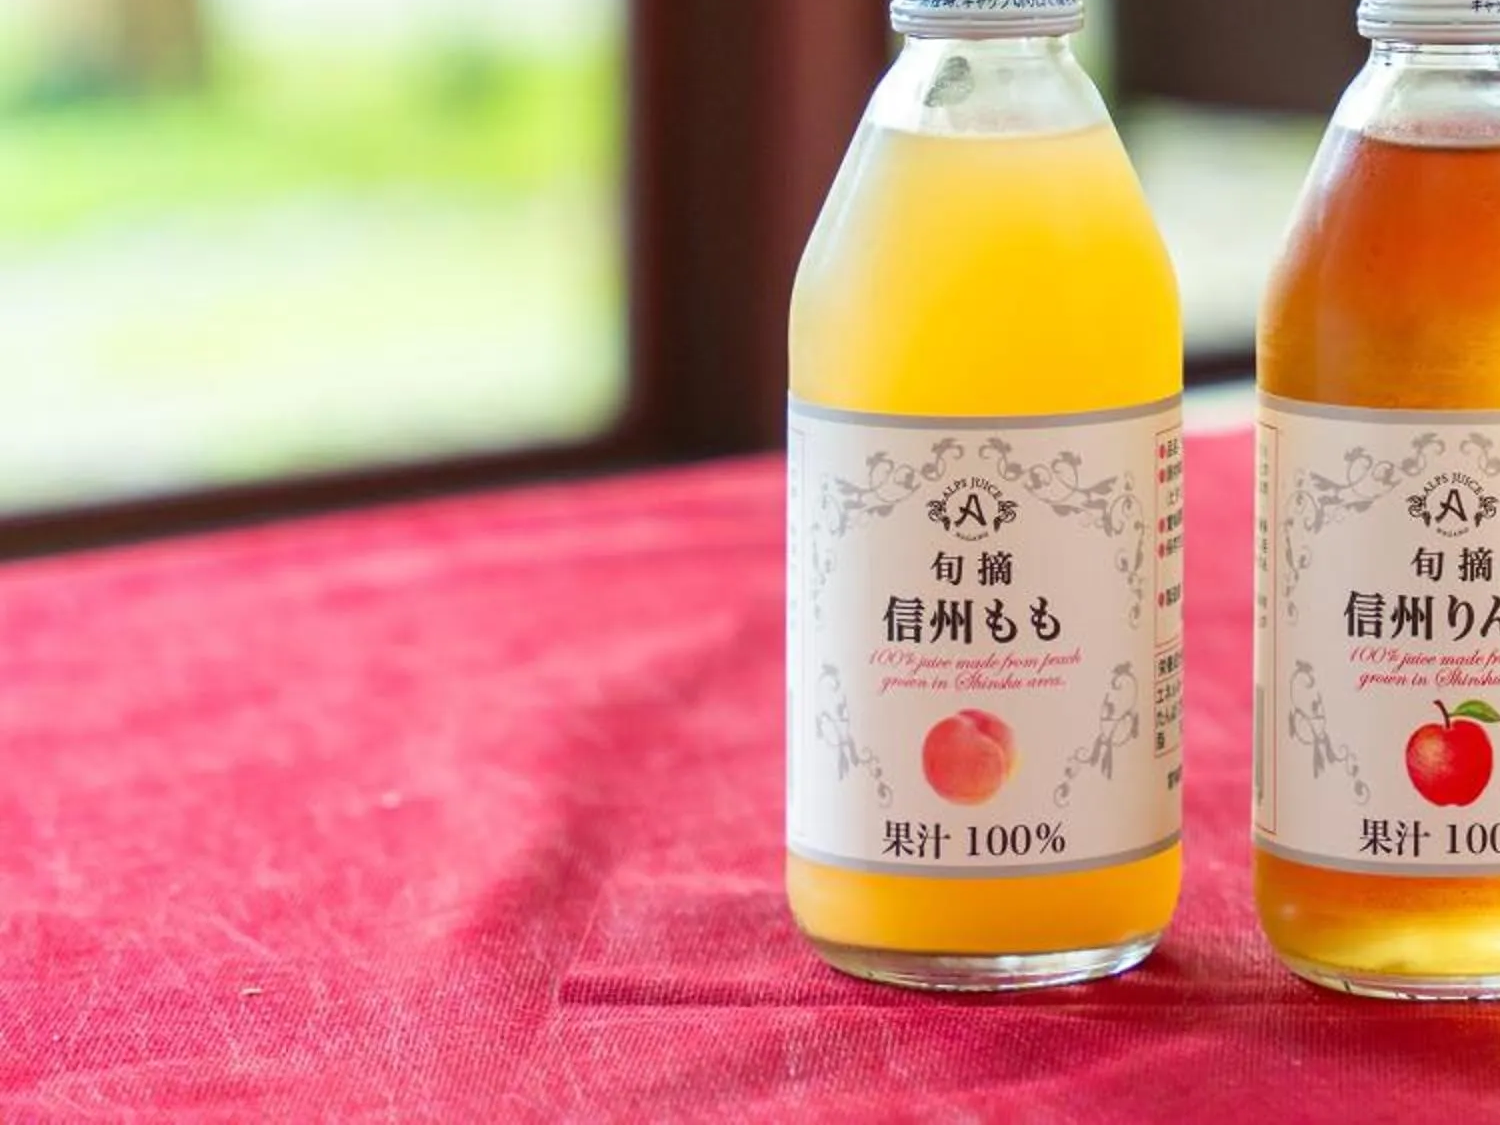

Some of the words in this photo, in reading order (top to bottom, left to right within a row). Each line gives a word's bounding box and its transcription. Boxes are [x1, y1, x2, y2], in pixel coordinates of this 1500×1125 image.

[969, 476, 1004, 501] JUICE
[1450, 471, 1485, 496] JUICE
[881, 596, 1062, 644] 信州もも
[955, 652, 1000, 670] made
[1000, 651, 1039, 672] from
[1350, 646, 1400, 663] 100%
[1440, 648, 1485, 666] made
[1410, 672, 1429, 686] in
